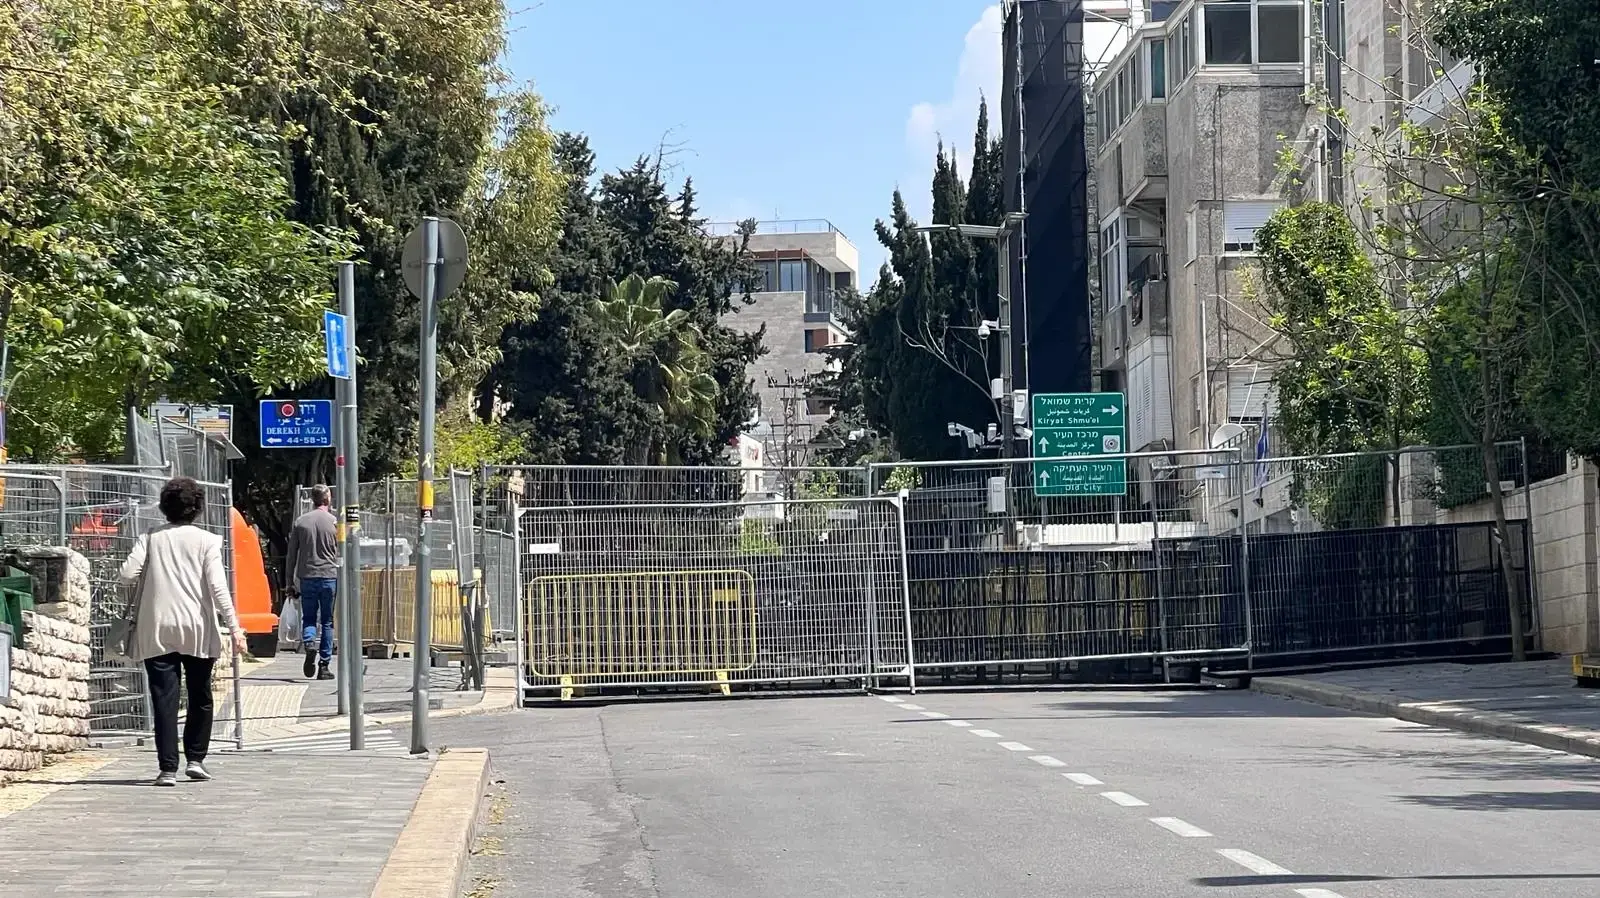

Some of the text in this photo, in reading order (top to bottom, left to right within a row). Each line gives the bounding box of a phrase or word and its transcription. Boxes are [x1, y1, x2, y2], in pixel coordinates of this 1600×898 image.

[1041, 397, 1095, 406] קרית שמואל
[298, 404, 316, 415] דרך
[1068, 416, 1100, 424] Shmu'el
[266, 426, 327, 435] DEREKH AZZA
[1053, 464, 1113, 473] העיר העתיקה
[1065, 482, 1102, 491] Old City
